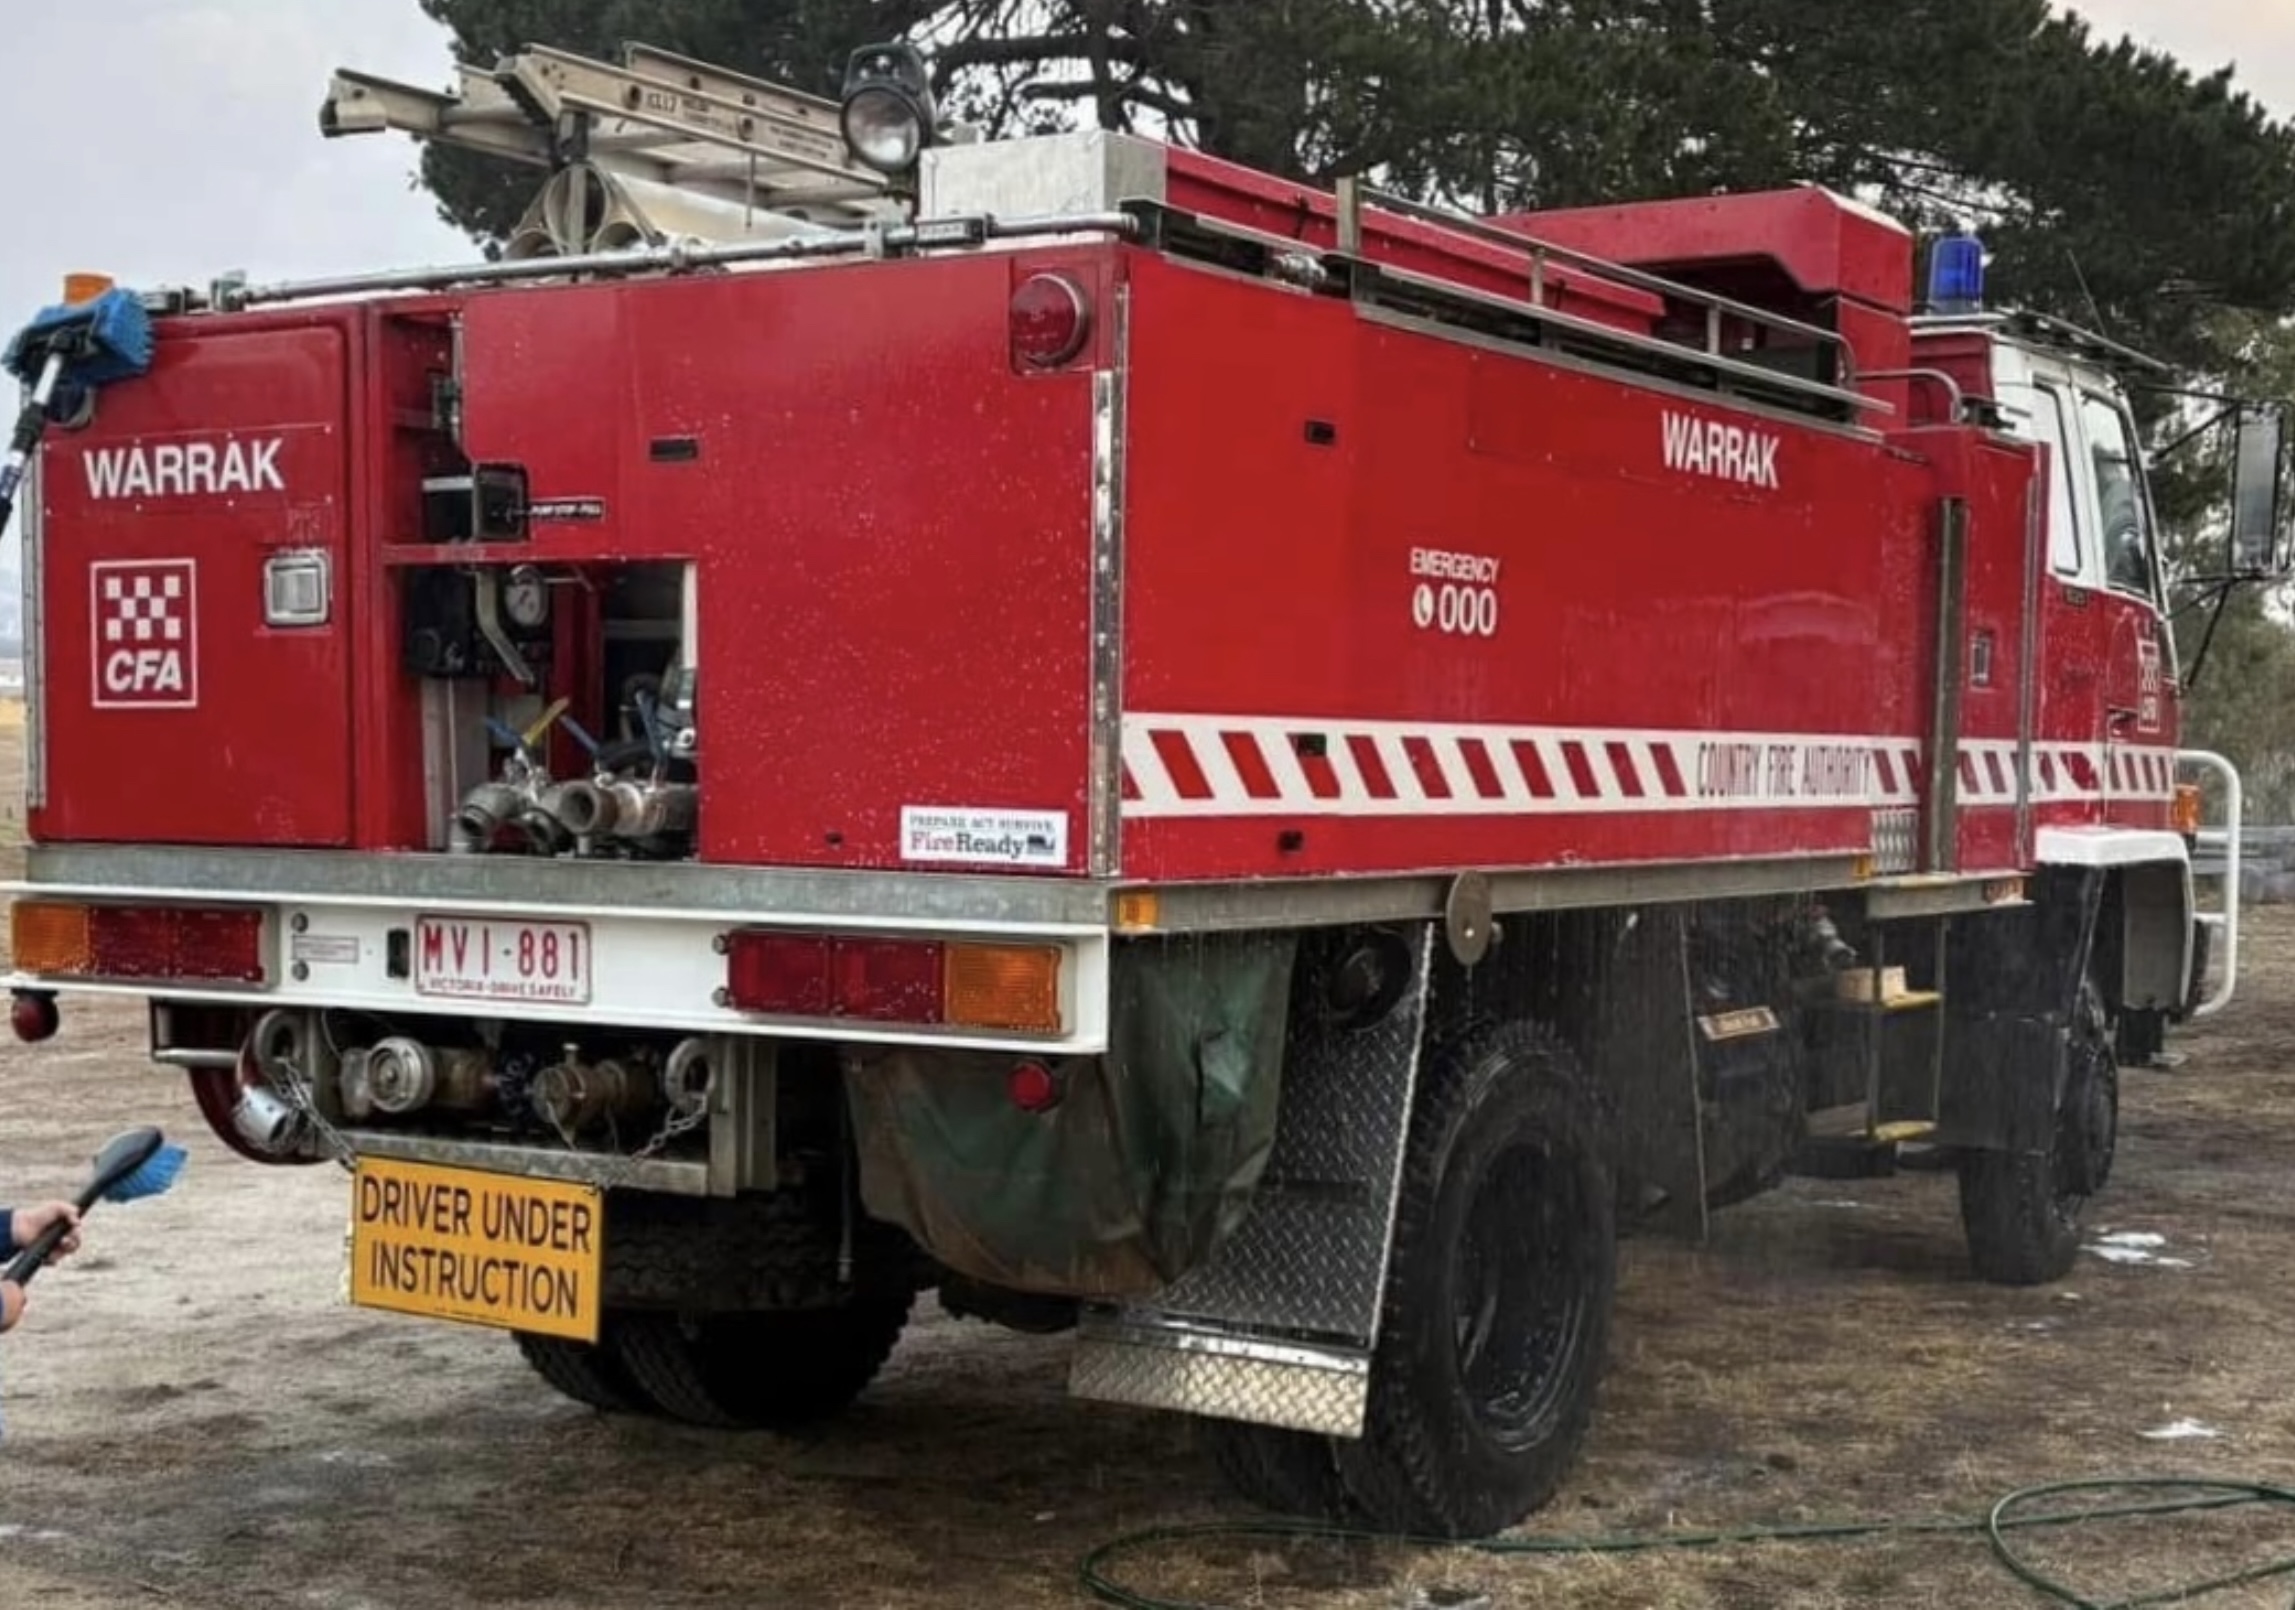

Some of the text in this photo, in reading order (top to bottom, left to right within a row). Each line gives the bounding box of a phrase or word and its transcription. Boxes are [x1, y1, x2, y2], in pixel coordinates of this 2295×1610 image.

[83, 437, 286, 499] WARRAK
[1661, 408, 1780, 490] WARRAK
[1410, 546, 1500, 585] EMERGENCY
[1438, 583, 1498, 636] 000
[106, 649, 183, 692] CFA
[1697, 741, 1871, 798] COUNTRY FIRE AUTHORITY
[910, 831, 1026, 860] FireReady
[361, 1174, 592, 1255] DRIVER UNDER
[370, 1239, 579, 1319] INSTRUCTION
